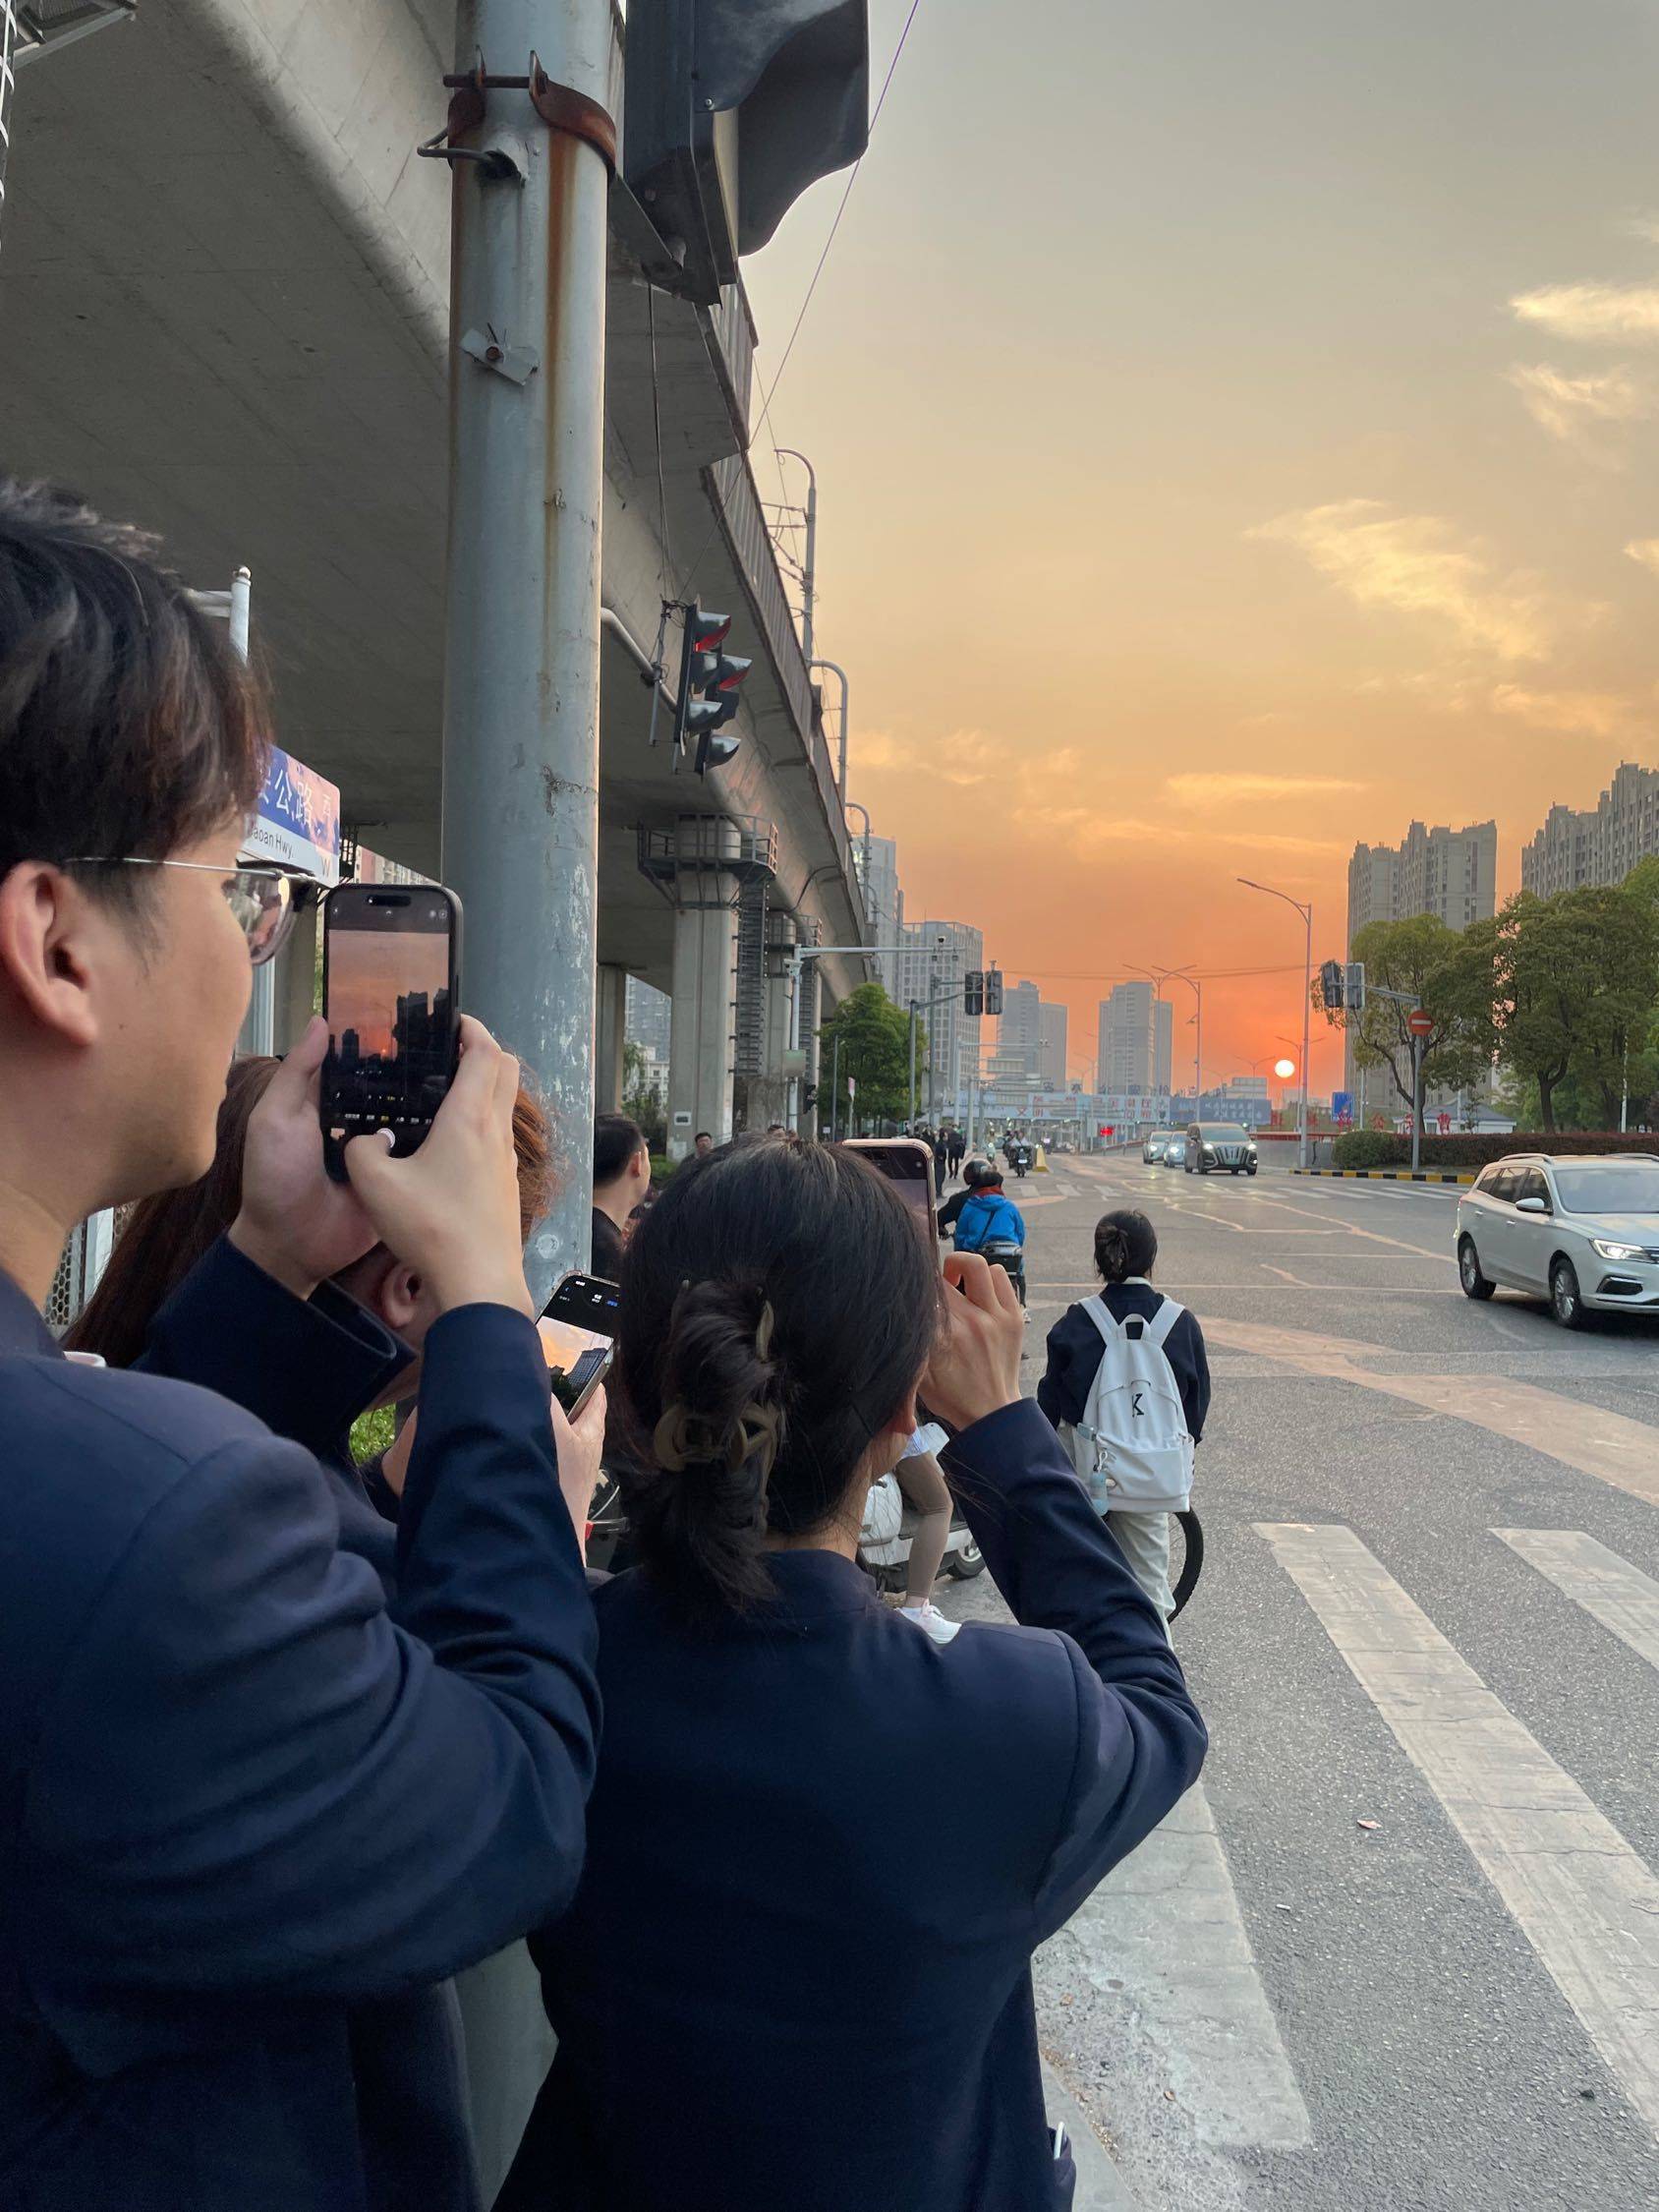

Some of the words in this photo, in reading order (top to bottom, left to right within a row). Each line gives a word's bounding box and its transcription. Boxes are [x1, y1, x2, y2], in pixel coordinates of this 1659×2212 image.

[252, 826, 274, 847] aoan
[275, 833, 294, 859] Hwy.
[321, 854, 331, 878] W
[1131, 1392, 1144, 1418] K
